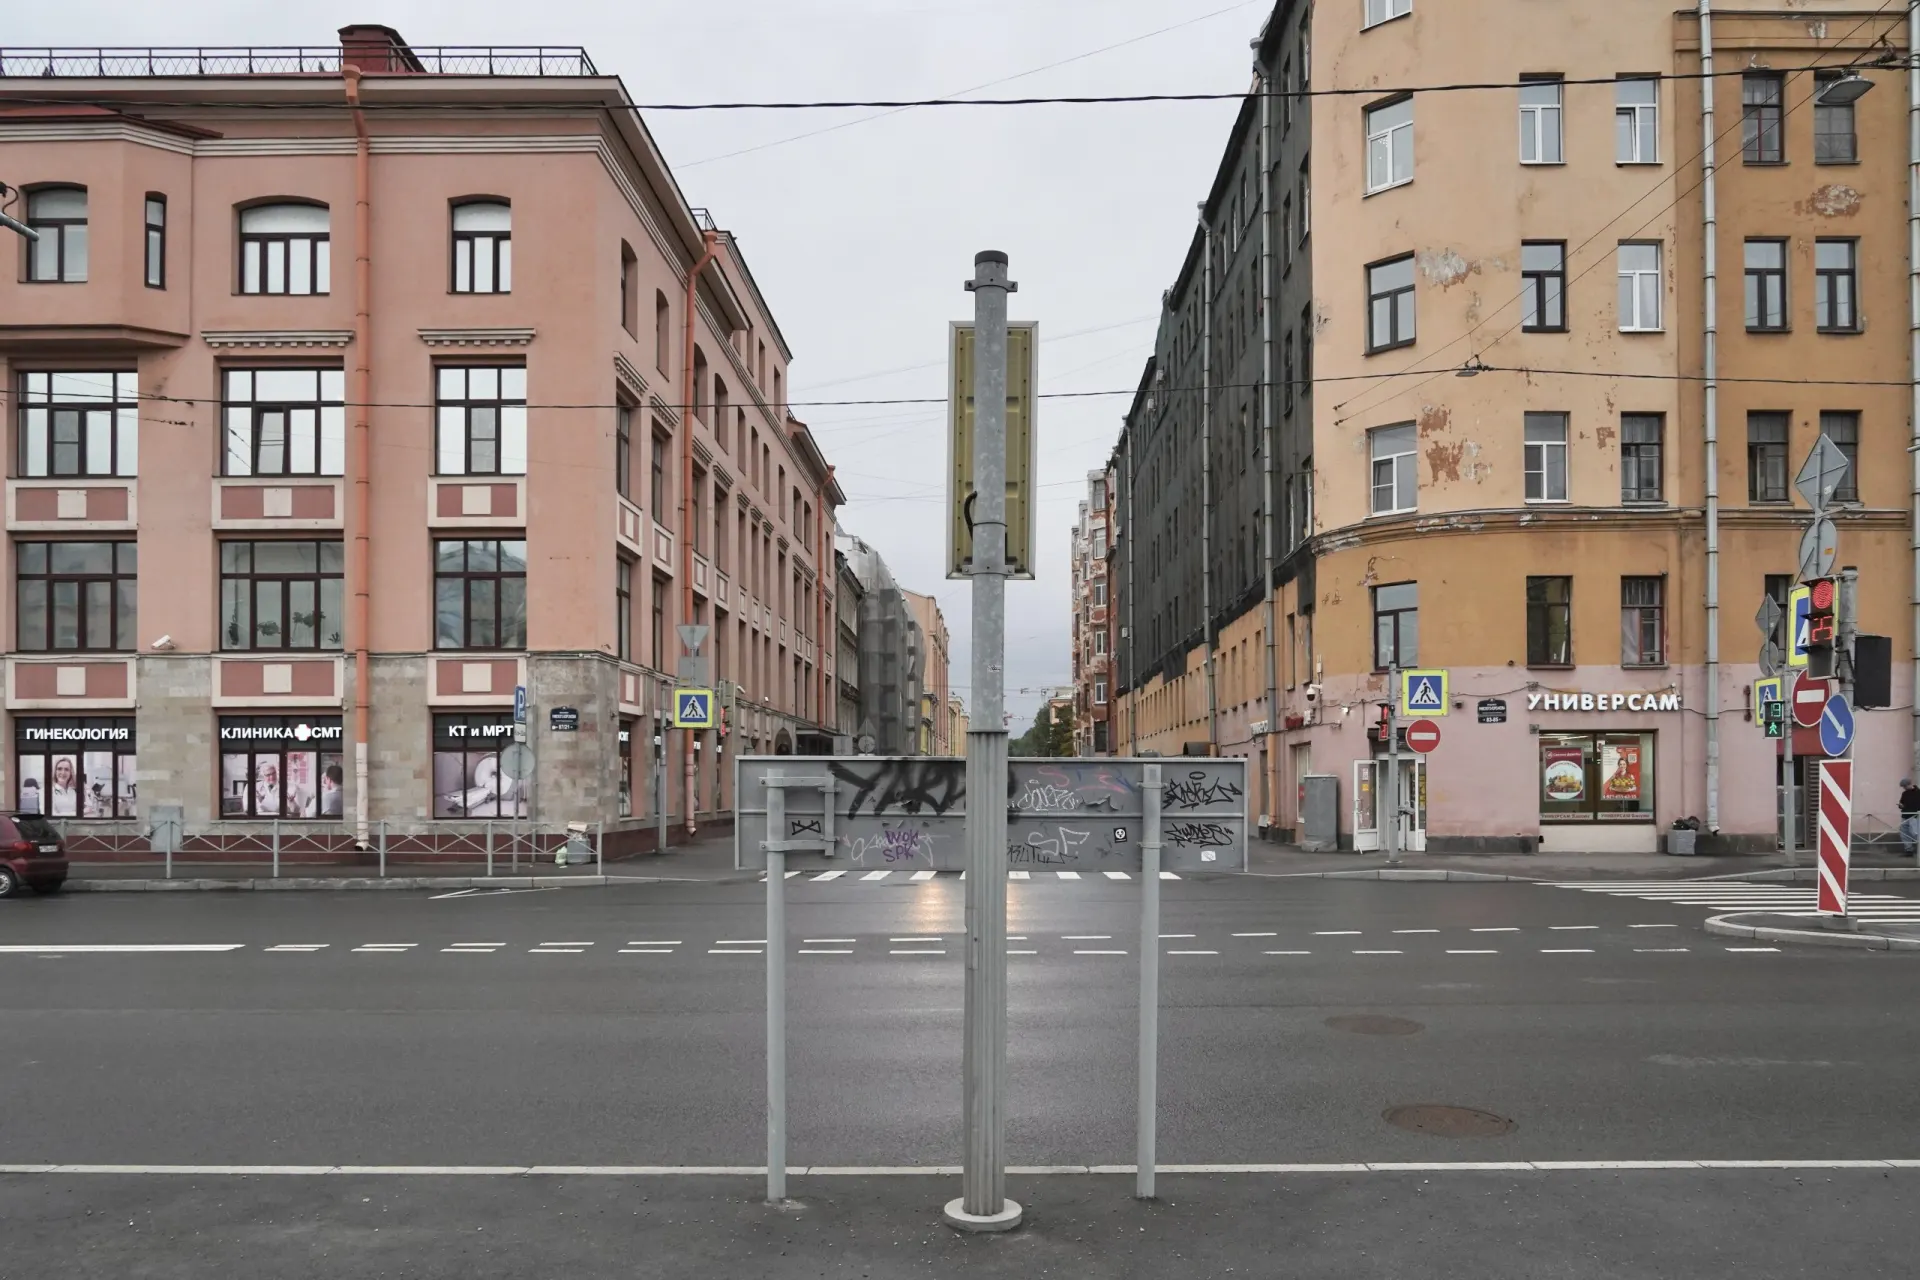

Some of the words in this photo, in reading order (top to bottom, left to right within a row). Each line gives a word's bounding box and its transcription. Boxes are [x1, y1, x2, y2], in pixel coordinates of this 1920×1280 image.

[1526, 693, 1680, 711] УНИВЕРСАМ
[26, 728, 129, 740] ГИНЕКОЛОГИЯ
[221, 727, 294, 739] КЛИНИКА
[311, 726, 342, 738] СМТ
[448, 725, 467, 737] КТ
[471, 728, 480, 737] и
[482, 725, 514, 737] МРТ
